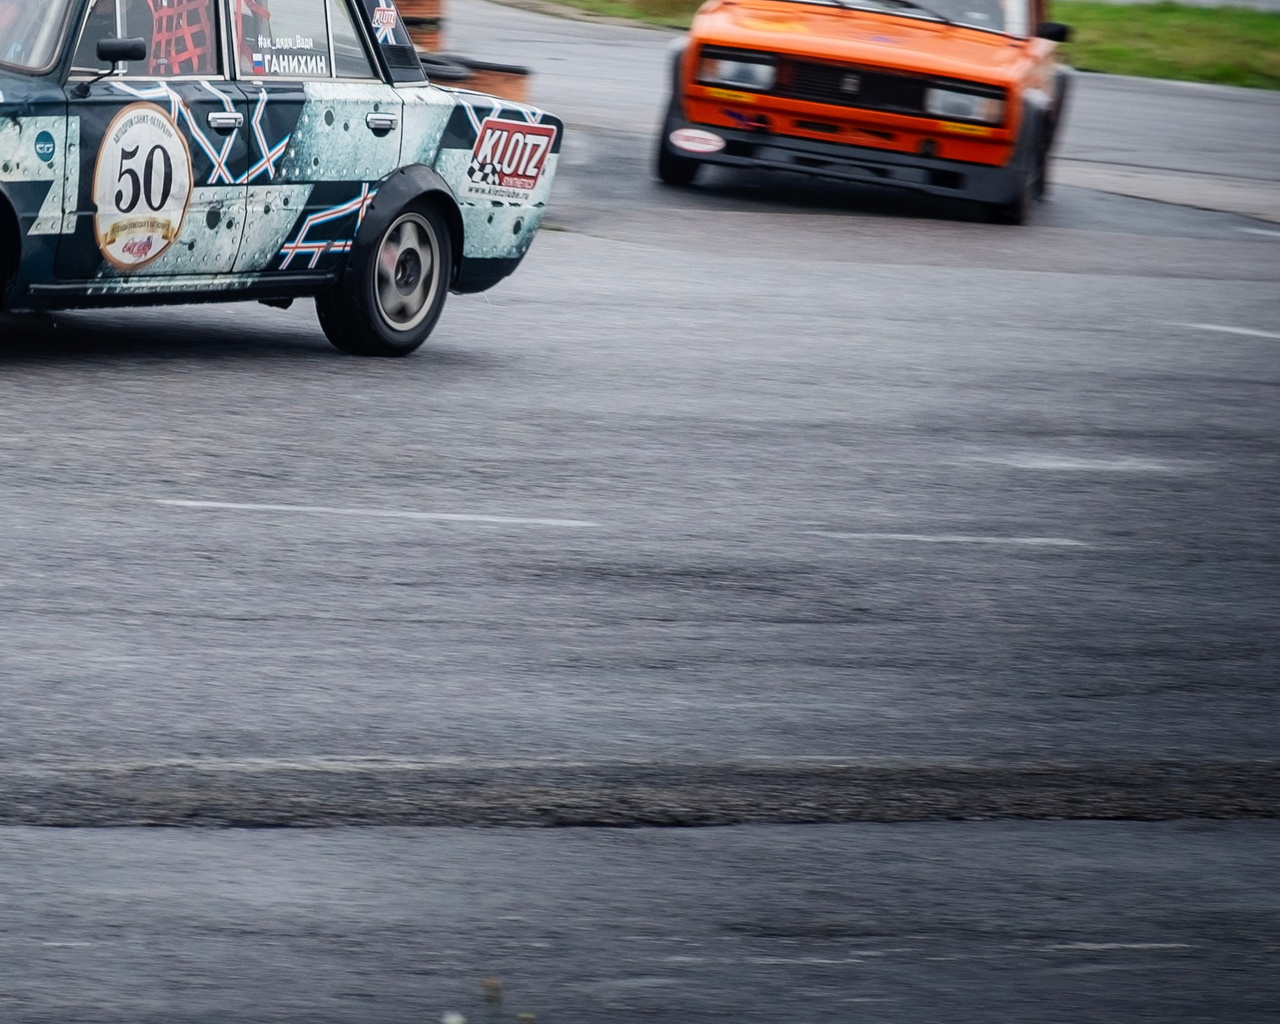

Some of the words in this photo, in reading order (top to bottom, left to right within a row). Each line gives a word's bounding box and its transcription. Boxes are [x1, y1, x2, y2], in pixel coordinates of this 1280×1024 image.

[375, 10, 396, 24] KLOTZ
[264, 54, 326, 74] ГАНИХИН
[477, 128, 550, 177] KLOTZ
[114, 144, 173, 214] 50
